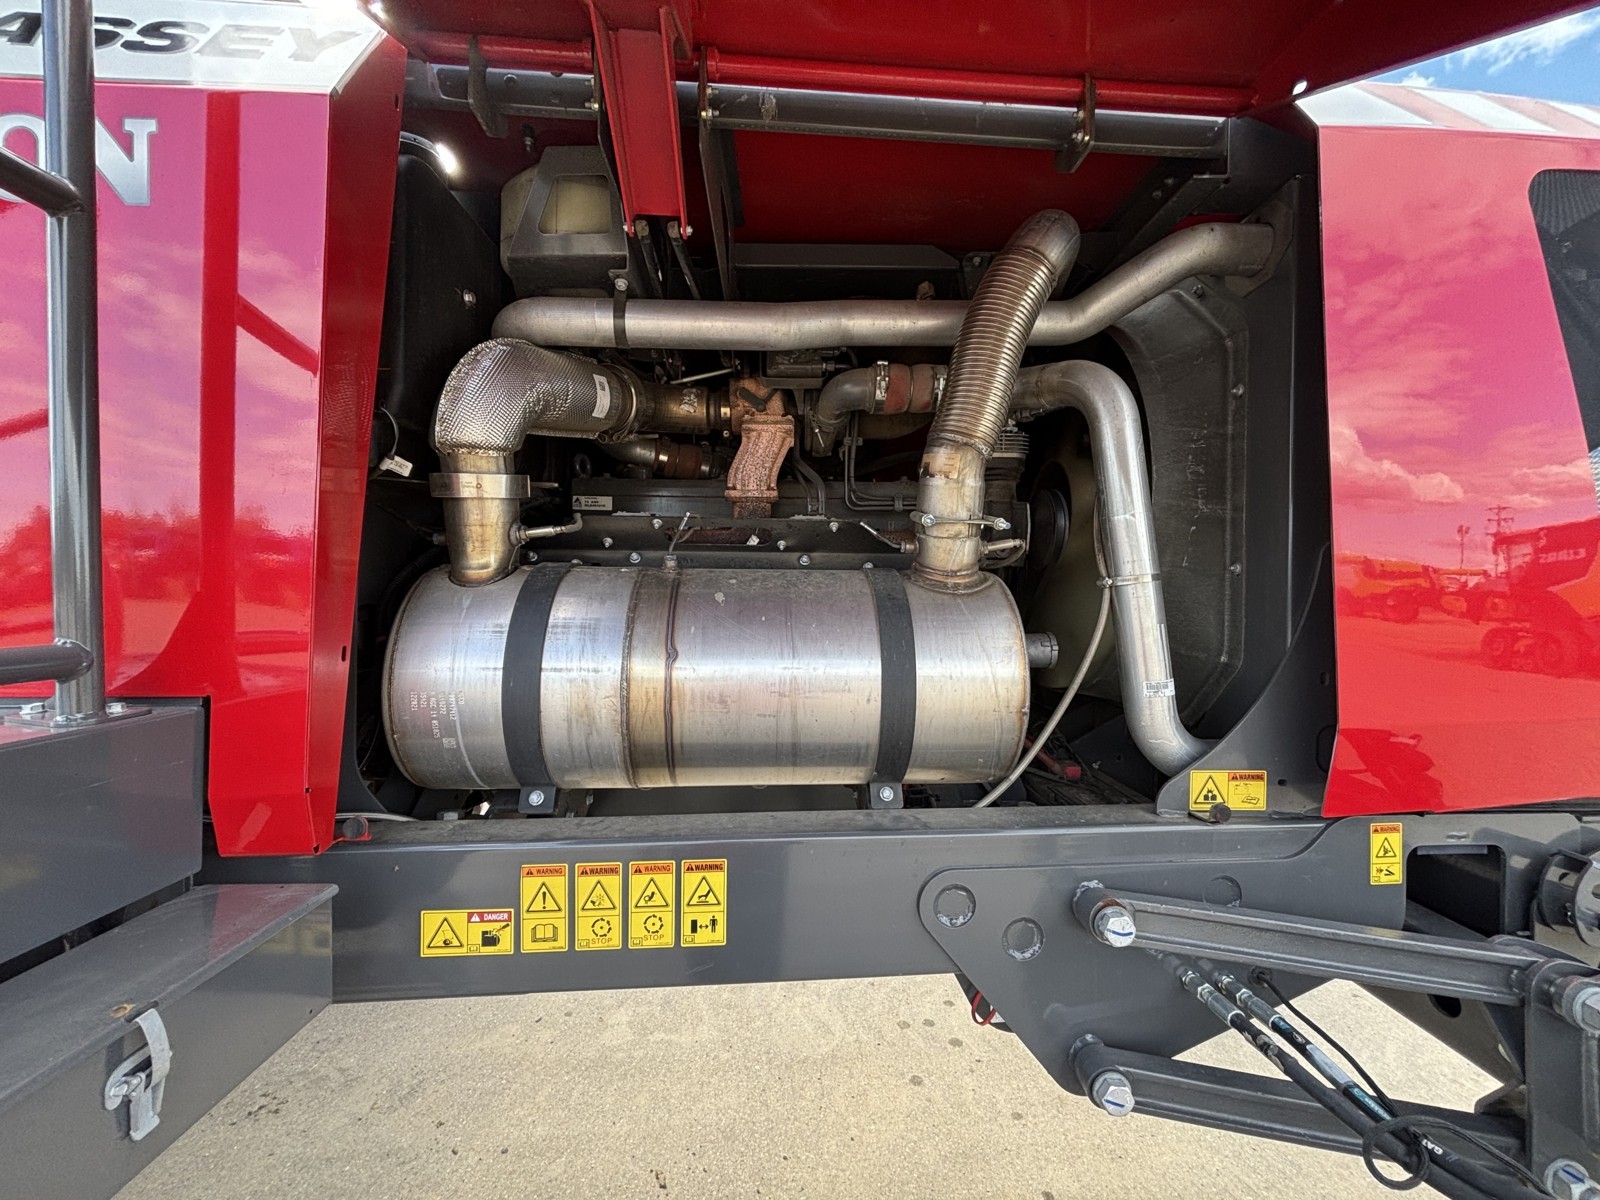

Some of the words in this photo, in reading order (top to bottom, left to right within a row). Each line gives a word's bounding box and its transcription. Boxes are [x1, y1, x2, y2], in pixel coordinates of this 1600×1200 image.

[1238, 773, 1265, 781] WARNING
[535, 867, 563, 875] WARNING
[588, 866, 619, 875] WARNING
[643, 864, 671, 873] WARNING
[694, 863, 724, 871] WARNING
[483, 912, 509, 921] DANGER
[590, 937, 613, 945] STOP
[643, 934, 665, 942] STOP
